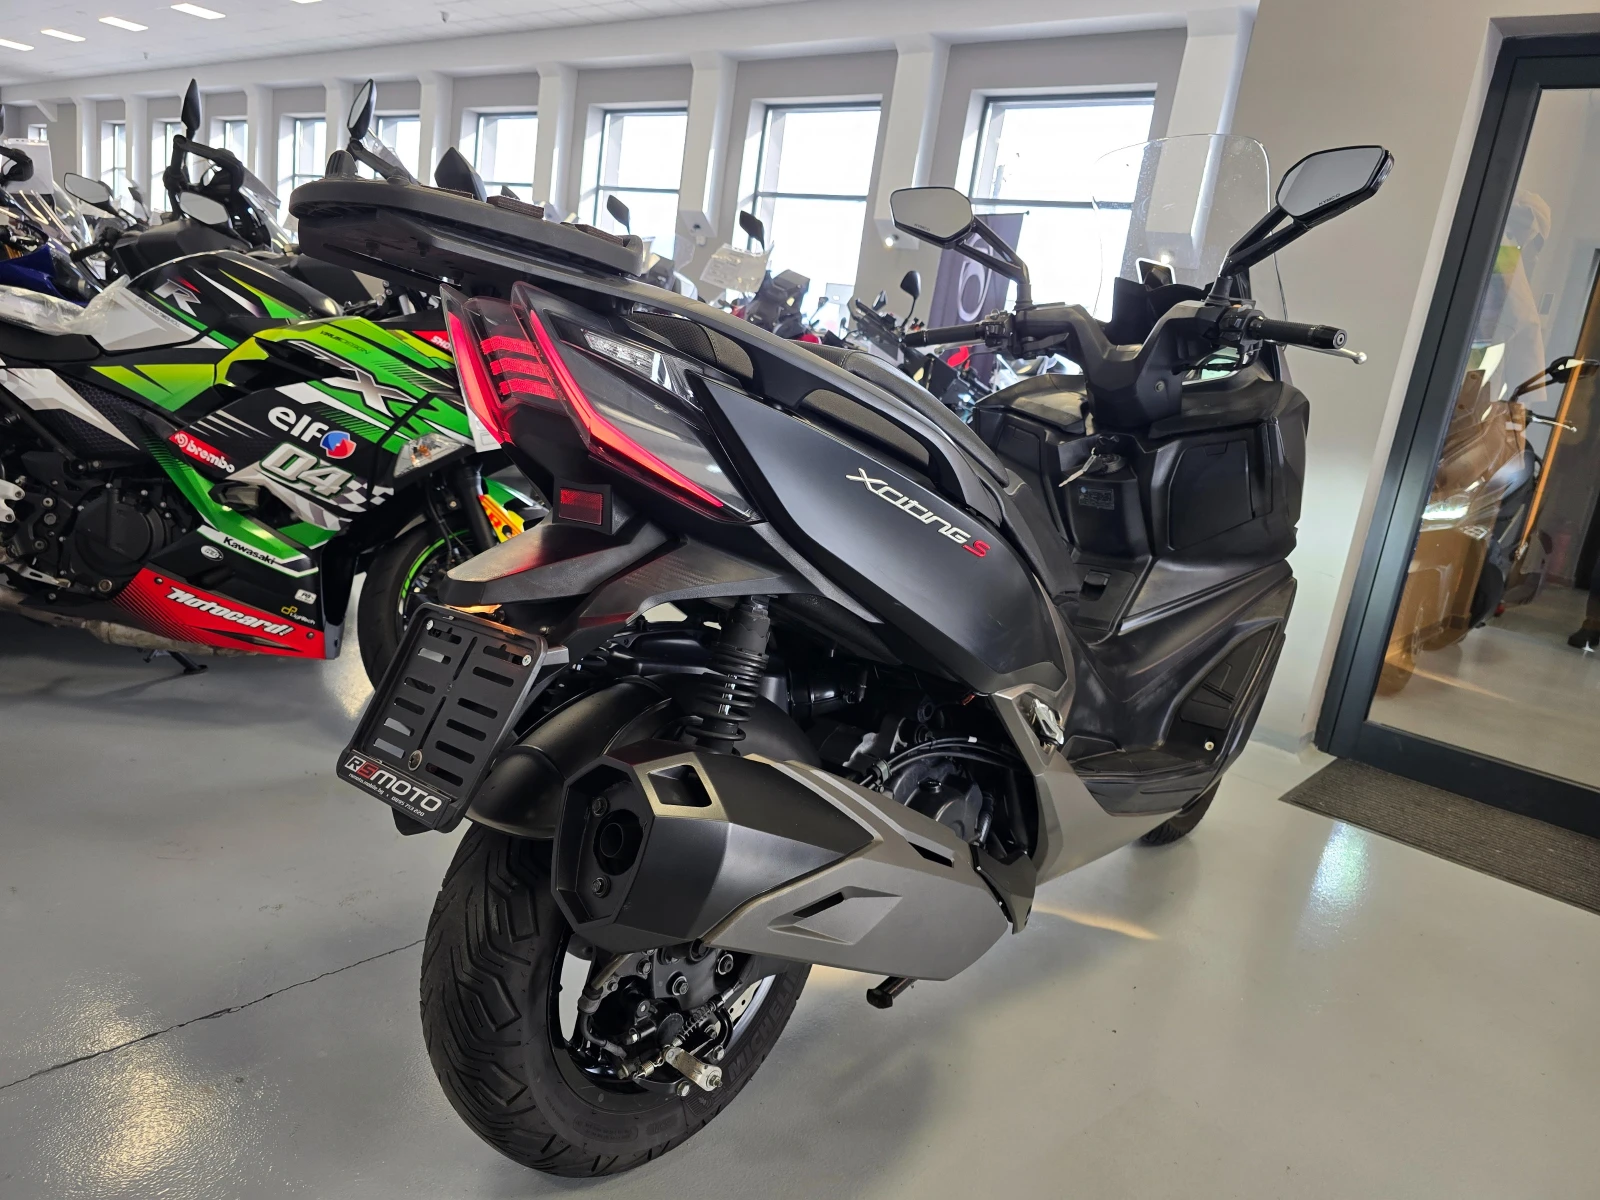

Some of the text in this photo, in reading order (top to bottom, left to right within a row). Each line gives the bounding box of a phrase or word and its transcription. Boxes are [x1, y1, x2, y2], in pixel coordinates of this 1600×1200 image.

[1318, 193, 1341, 206] KYMCO
[430, 335, 453, 352] SHO
[267, 406, 330, 443] elf
[186, 439, 236, 474] brembo
[258, 441, 355, 499] 04
[223, 536, 278, 565] Kawasaki
[344, 755, 442, 812] RSMOTO
